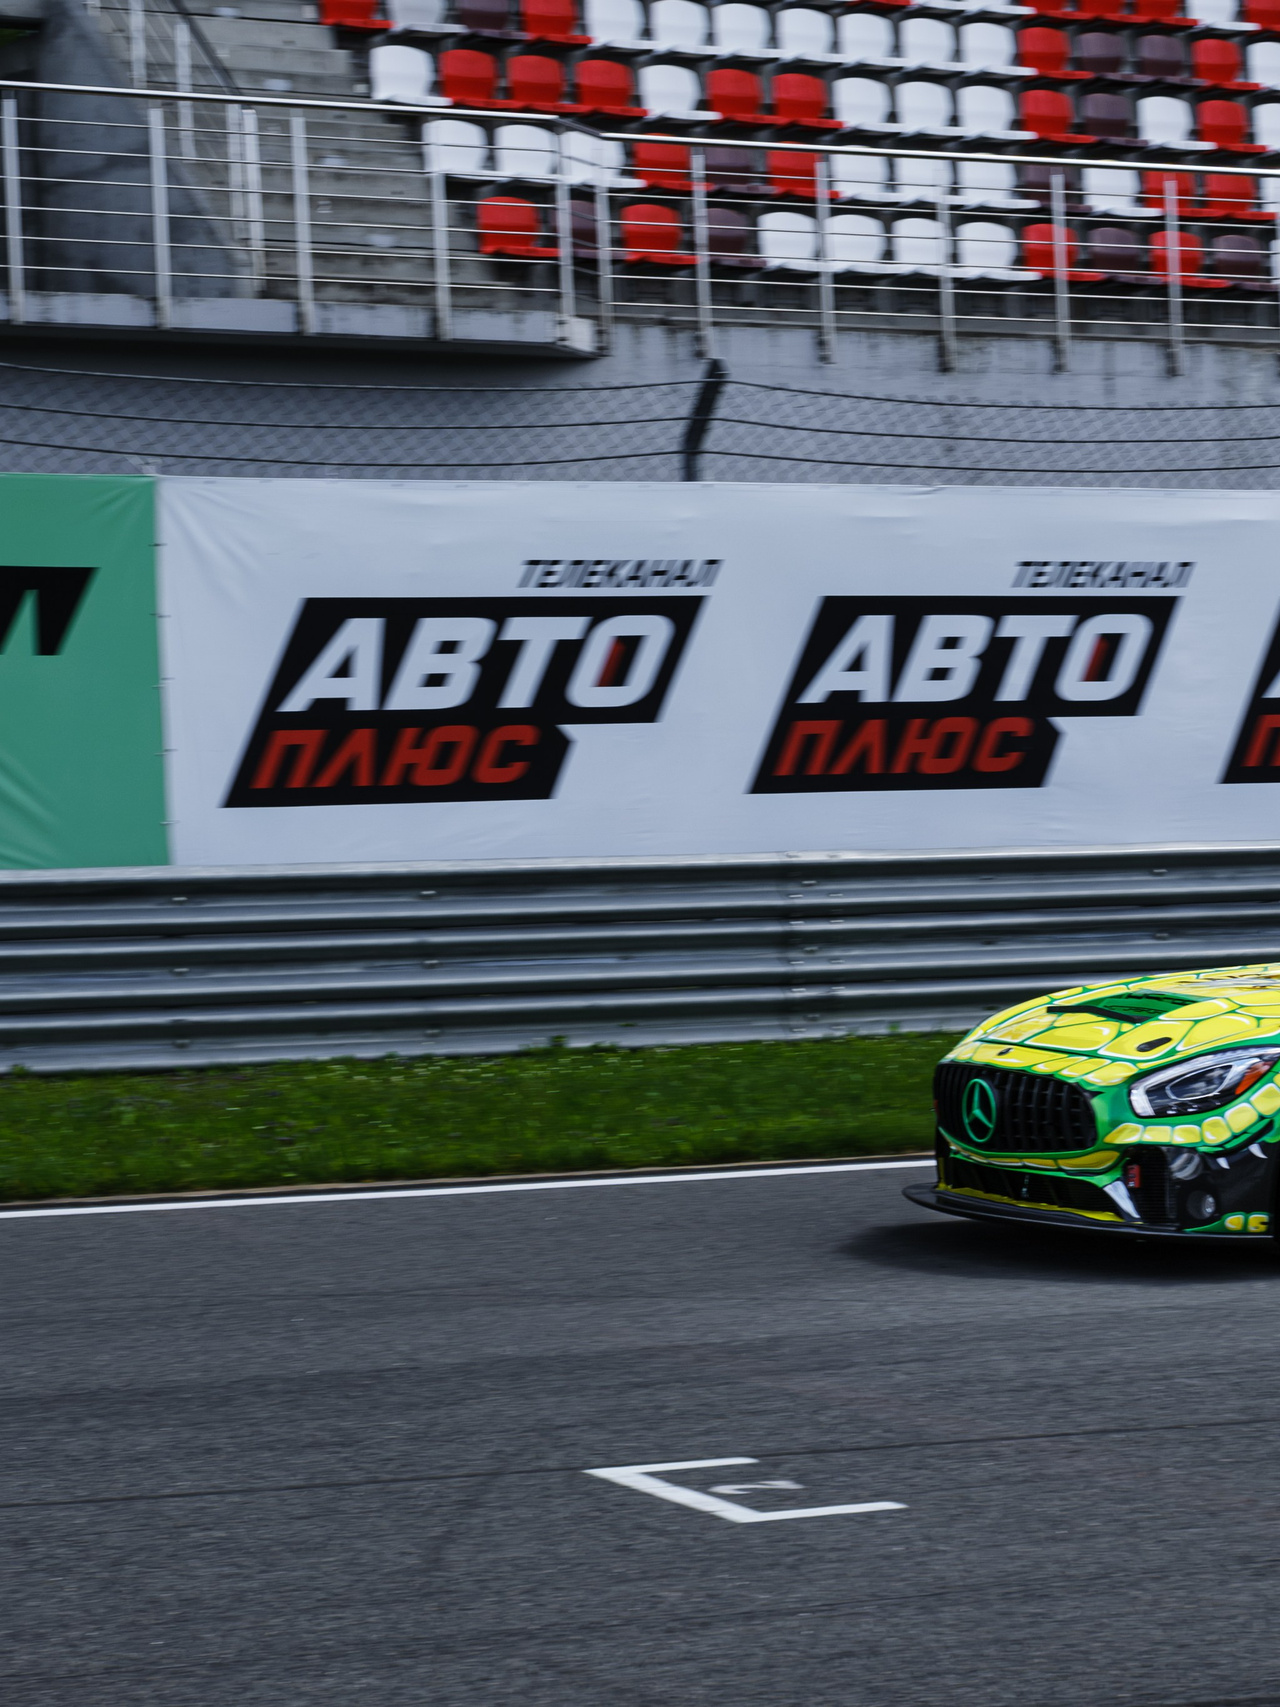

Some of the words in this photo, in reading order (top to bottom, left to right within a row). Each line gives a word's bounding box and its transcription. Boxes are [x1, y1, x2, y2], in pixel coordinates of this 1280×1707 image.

[516, 560, 724, 588] ТЕЛЕКАНАЛ
[1010, 561, 1197, 588] ТЕЛЕКАНАЛ
[275, 614, 676, 712] АВТО
[797, 613, 1154, 705] АВТО
[250, 725, 541, 790] ПЛЮС
[773, 716, 1036, 777] ПЛЮС
